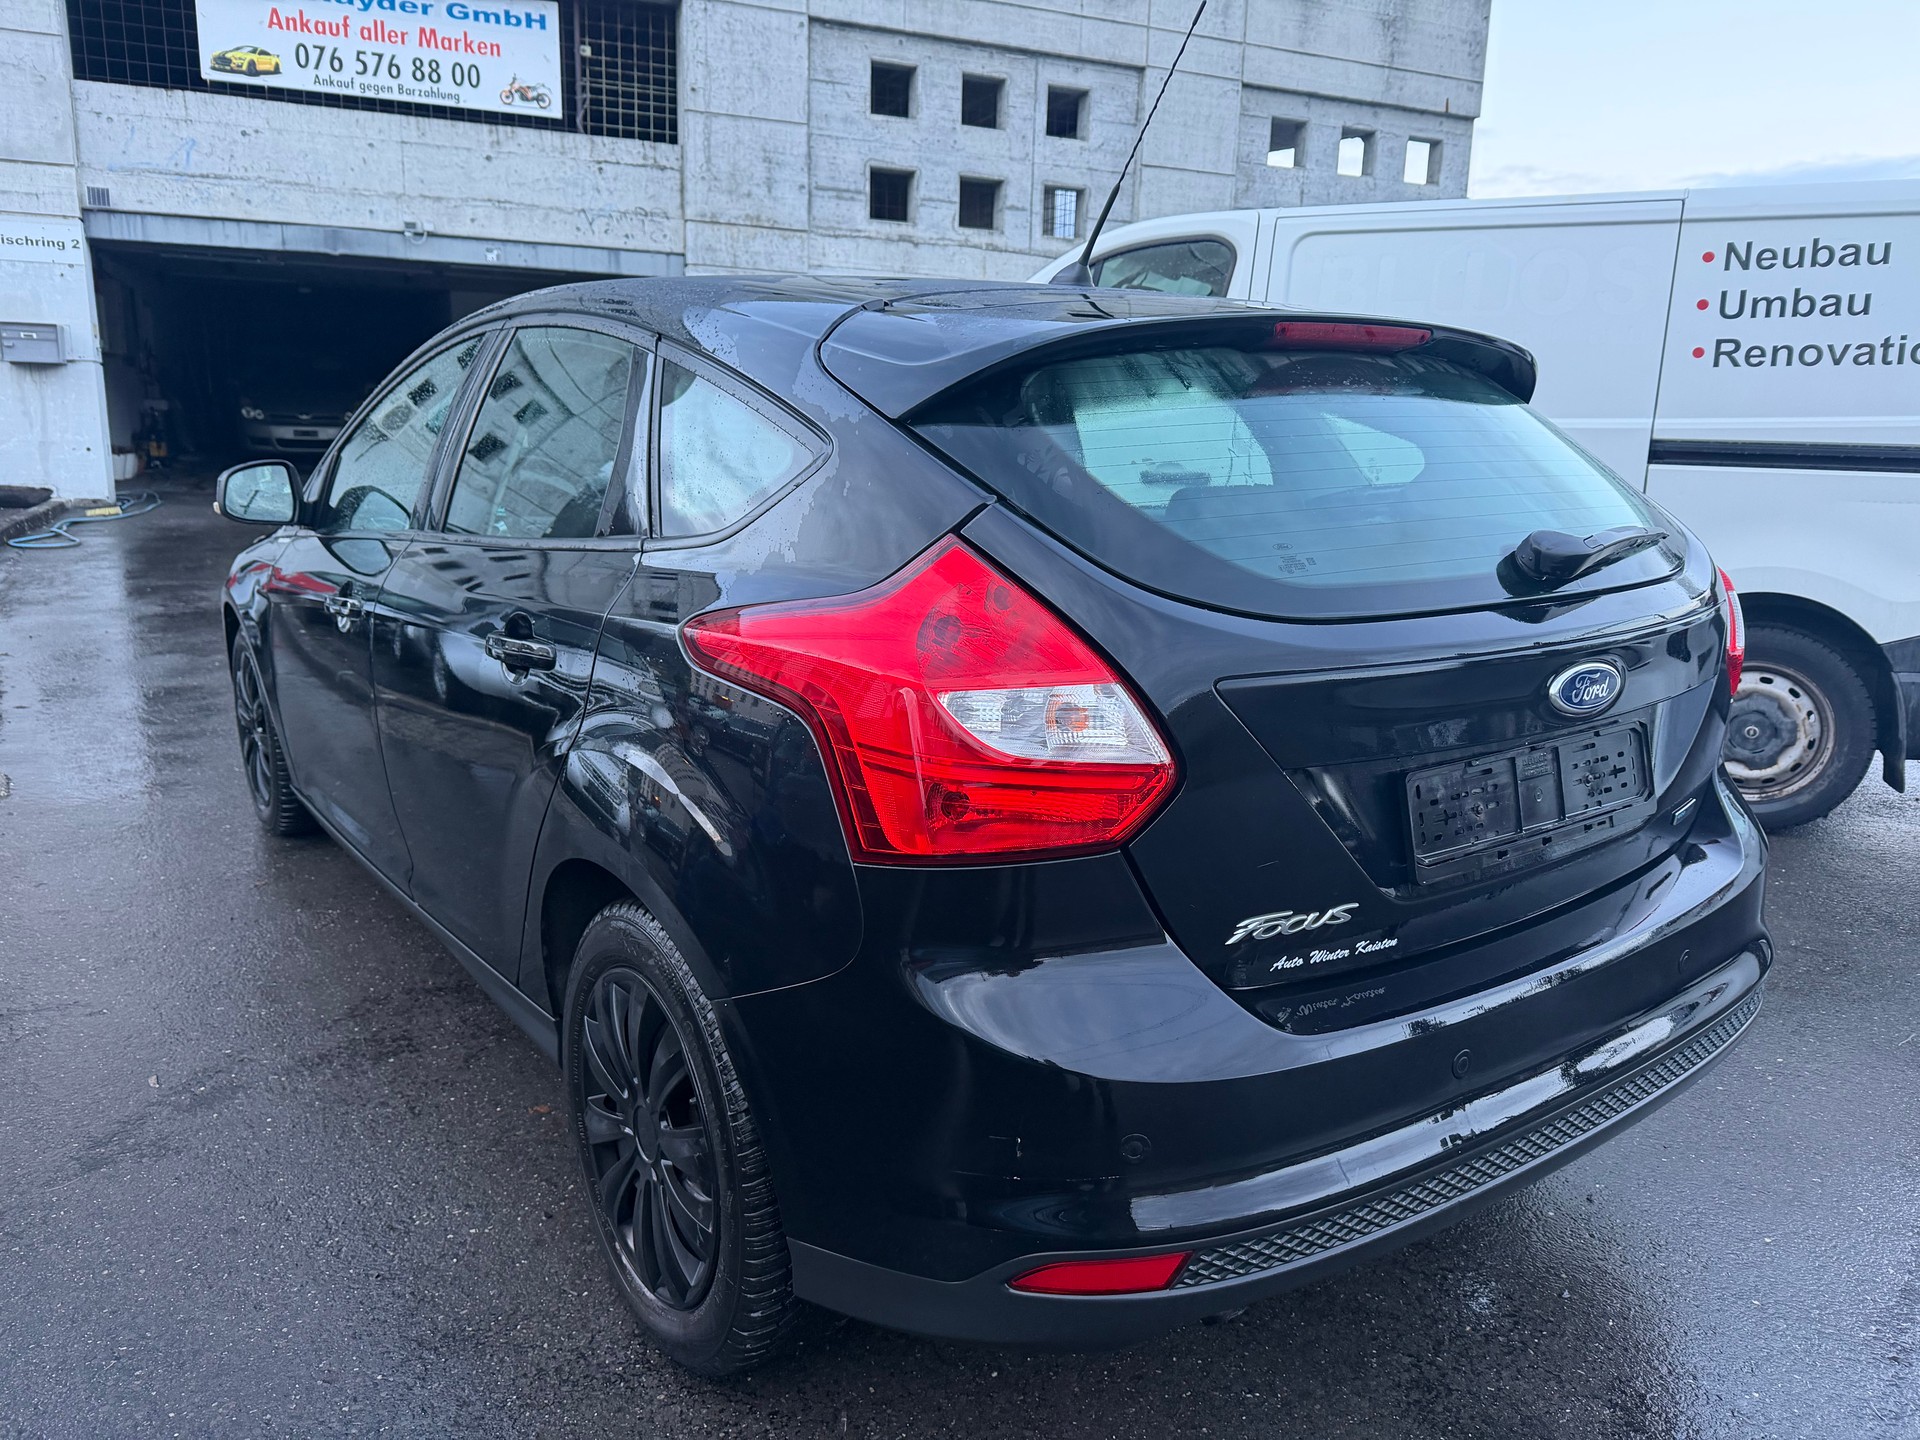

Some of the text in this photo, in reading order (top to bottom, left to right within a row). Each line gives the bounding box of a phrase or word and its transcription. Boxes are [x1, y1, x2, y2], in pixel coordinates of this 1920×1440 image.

[267, 7, 502, 58] Ankauf aller Marken
[446, 3, 547, 31] GmbH
[294, 42, 482, 89] 076 576 88 00
[313, 74, 461, 105] Ankauf gegen Barzahlung
[71, 239, 81, 249] 2
[1723, 237, 1892, 272] Neubau
[1718, 287, 1873, 320] Umbau
[1572, 672, 1610, 703] Ford
[1269, 937, 1399, 972] Auto Winter Kaisten
